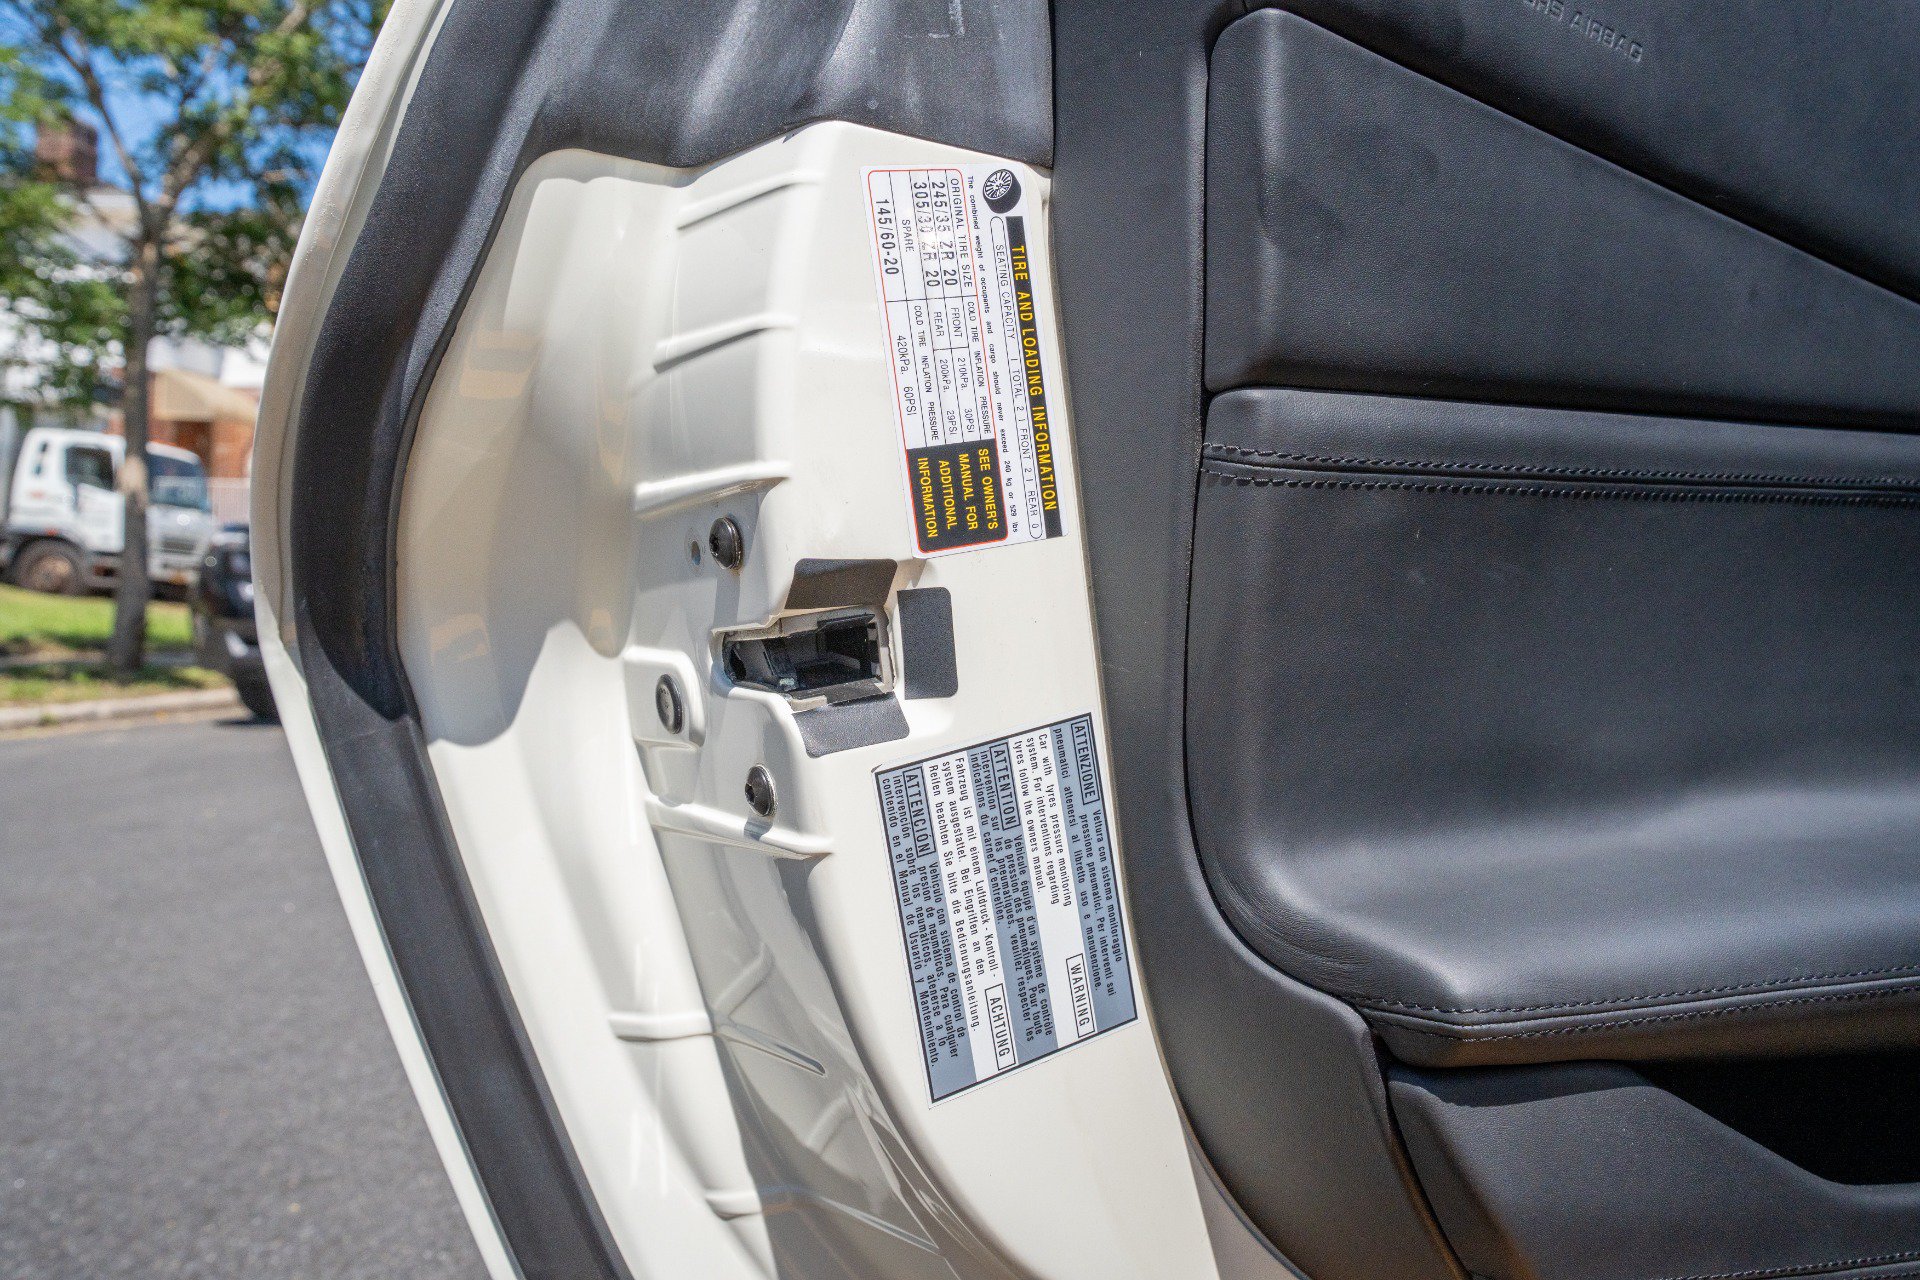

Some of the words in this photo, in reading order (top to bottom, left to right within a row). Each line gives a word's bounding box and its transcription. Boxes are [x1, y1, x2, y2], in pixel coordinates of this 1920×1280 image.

[1571, 11, 1642, 62] AIRBAG
[950, 178, 964, 229] ORIGINAL
[969, 194, 979, 229] combined
[874, 198, 899, 275] 145/60-20
[901, 219, 914, 252] SPARE
[957, 235, 968, 258] TIRE
[973, 235, 983, 258] weight
[925, 270, 940, 287] 20
[942, 269, 957, 285] 20
[961, 264, 972, 287] SIZE
[995, 244, 1008, 286] SEATING
[1011, 245, 1028, 280] TIRE
[966, 301, 976, 321] COLD
[979, 277, 990, 313] occupants
[1017, 291, 1033, 321] AND
[912, 305, 923, 325] COLD
[932, 311, 943, 336] REAR
[950, 307, 962, 337] FRONT
[1001, 291, 1015, 339] CAPACITY
[916, 331, 926, 347] TIRE
[970, 327, 978, 342] TIRE
[973, 350, 984, 386] INFLATION
[987, 343, 995, 363] cargo
[1022, 328, 1042, 396] LOADING
[920, 355, 932, 392] INFLATION
[992, 371, 1000, 394] should
[1011, 369, 1022, 398] TOTAL
[903, 386, 916, 415] 60PSI
[979, 396, 990, 434] PRESSURE
[926, 401, 939, 440] PRESSURE
[946, 410, 957, 434] 29PSI
[963, 408, 974, 432] 30PSI
[1000, 428, 1008, 452] exceed
[1018, 428, 1030, 460] FRONT
[977, 448, 990, 470] SEE
[1031, 406, 1056, 511] INFORMATION
[958, 453, 974, 500] MANUAL
[916, 457, 938, 537] INFORMATION
[938, 459, 957, 529] ADDITIONAL
[981, 476, 998, 529] OWNER'S
[1026, 490, 1037, 516] REAR
[965, 505, 978, 529] FOR
[1011, 740, 1025, 765] tyres
[1037, 733, 1048, 750] Car
[1041, 756, 1052, 776] with
[1074, 724, 1095, 798] ATTENZIONE
[928, 764, 942, 796] Reifen
[940, 760, 955, 795] system
[952, 757, 970, 801] Fahrzeug
[979, 750, 997, 810] intervention
[993, 747, 1016, 825] ATTENTION
[1017, 767, 1030, 797] follow
[1032, 776, 1042, 792] For
[881, 777, 898, 828] contenido
[905, 771, 932, 853] ATTENCIÓN
[970, 752, 987, 807] indications
[983, 831, 996, 863] carnet
[1023, 800, 1033, 816] the
[1044, 784, 1057, 808] tyres
[934, 801, 950, 845] beachten
[962, 806, 973, 819] ist
[1035, 795, 1053, 856] interventions
[1052, 727, 1069, 779] pneumatici
[1063, 785, 1077, 827] attenersi
[1073, 849, 1086, 884] libretto
[1080, 890, 1088, 907] uso
[1092, 809, 1104, 843] Vettura
[966, 824, 976, 840] mit
[994, 837, 1004, 852] les
[1003, 838, 1013, 850] de
[1026, 819, 1037, 852] owners
[1049, 813, 1063, 854] pressure
[1078, 813, 1093, 858] pressione
[943, 850, 954, 866] Sie
[969, 845, 982, 875] einem
[1097, 846, 1106, 862] con
[897, 869, 912, 907] Manual
[946, 871, 958, 894] bitte
[960, 868, 970, 884] Bei
[1004, 853, 1020, 897] pression
[1044, 859, 1061, 905] regarding
[1056, 857, 1073, 907] monitoring
[1101, 865, 1113, 900] sistema
[925, 905, 935, 918] de
[936, 907, 945, 925] con
[951, 898, 962, 915] die
[962, 888, 979, 936] Eingriffen
[975, 879, 990, 924] Luftdruck
[1013, 896, 1023, 913] des
[904, 846, 917, 875] sobre
[911, 882, 921, 899] los
[927, 973, 942, 1016] atenerse
[905, 913, 915, 926] de
[1096, 916, 1105, 932] Per
[1105, 903, 1123, 963] monitoraggio
[908, 931, 923, 970] Usuario
[940, 929, 954, 967] sistema
[984, 933, 998, 971] Kontroll
[1010, 933, 1023, 971] veuillez
[1099, 935, 1112, 979] interventi
[947, 971, 957, 984] de
[975, 957, 986, 975] den
[939, 986, 950, 1009] Para
[950, 987, 963, 1021] control
[1015, 975, 1032, 1022] respecter
[1028, 986, 1039, 1010] Pour
[1070, 963, 1089, 1026] WARNING
[1106, 982, 1115, 996] sui
[942, 1013, 959, 1059] cualquier
[956, 1025, 966, 1038] de
[989, 995, 1010, 1057] ACHTUNG
[1025, 1026, 1035, 1041] les
[1032, 1010, 1043, 1035] toute
